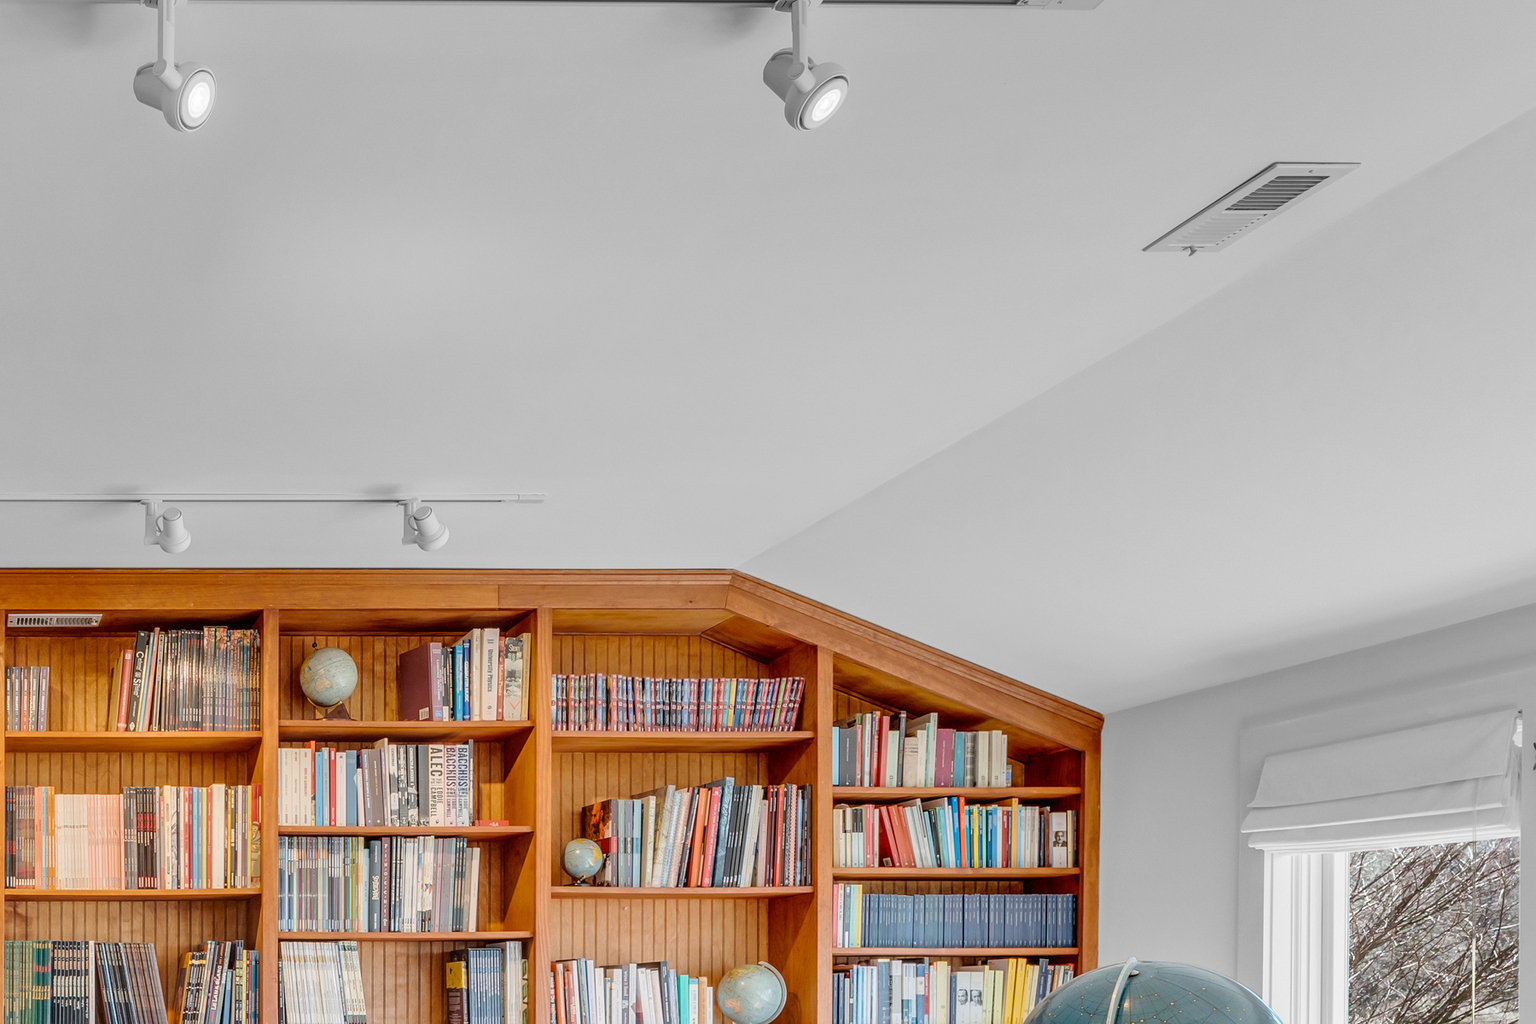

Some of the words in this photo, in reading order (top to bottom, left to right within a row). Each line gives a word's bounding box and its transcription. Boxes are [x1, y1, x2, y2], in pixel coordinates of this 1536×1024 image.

[430, 747, 443, 777] ALEC
[446, 747, 456, 787] BACCHUS
[458, 747, 468, 787] BACCHUS
